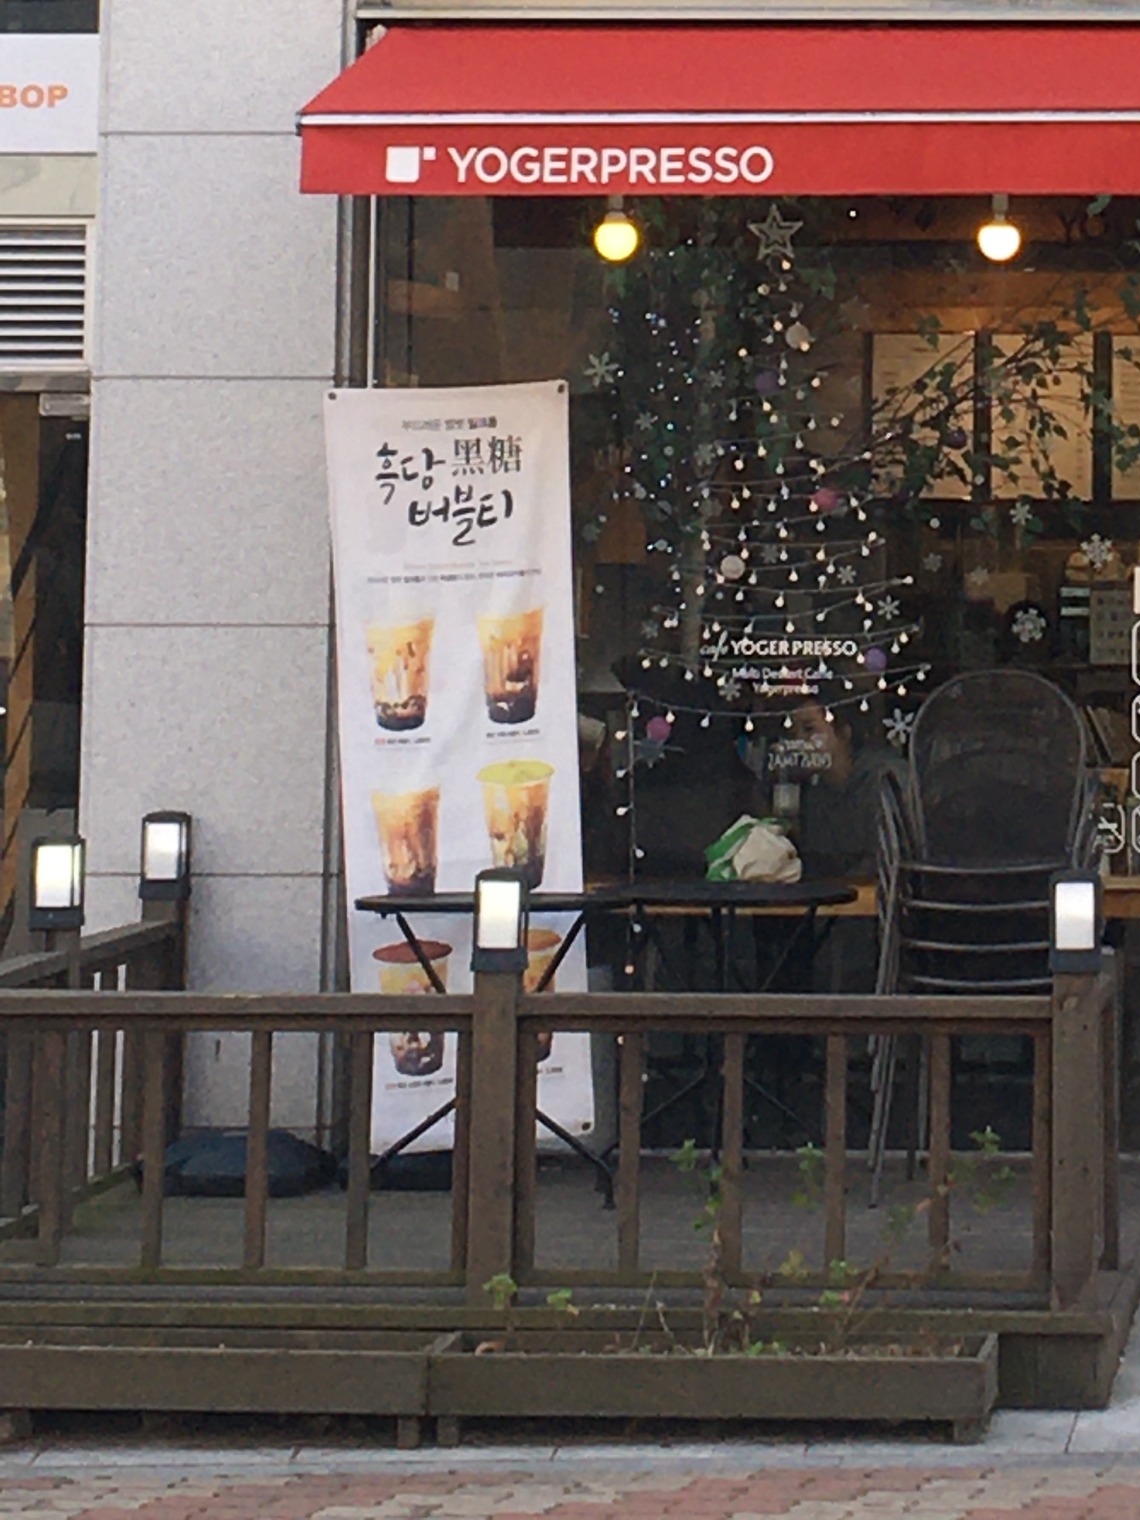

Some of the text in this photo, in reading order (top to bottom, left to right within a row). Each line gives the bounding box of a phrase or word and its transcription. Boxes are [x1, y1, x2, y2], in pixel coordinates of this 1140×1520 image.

[0, 85, 68, 109] BOP
[447, 146, 774, 184] YOGERPRESSO
[375, 442, 446, 505] 흑당
[408, 484, 514, 547] 버블티
[730, 639, 790, 656] YOGER
[791, 639, 858, 656] PRESSO
